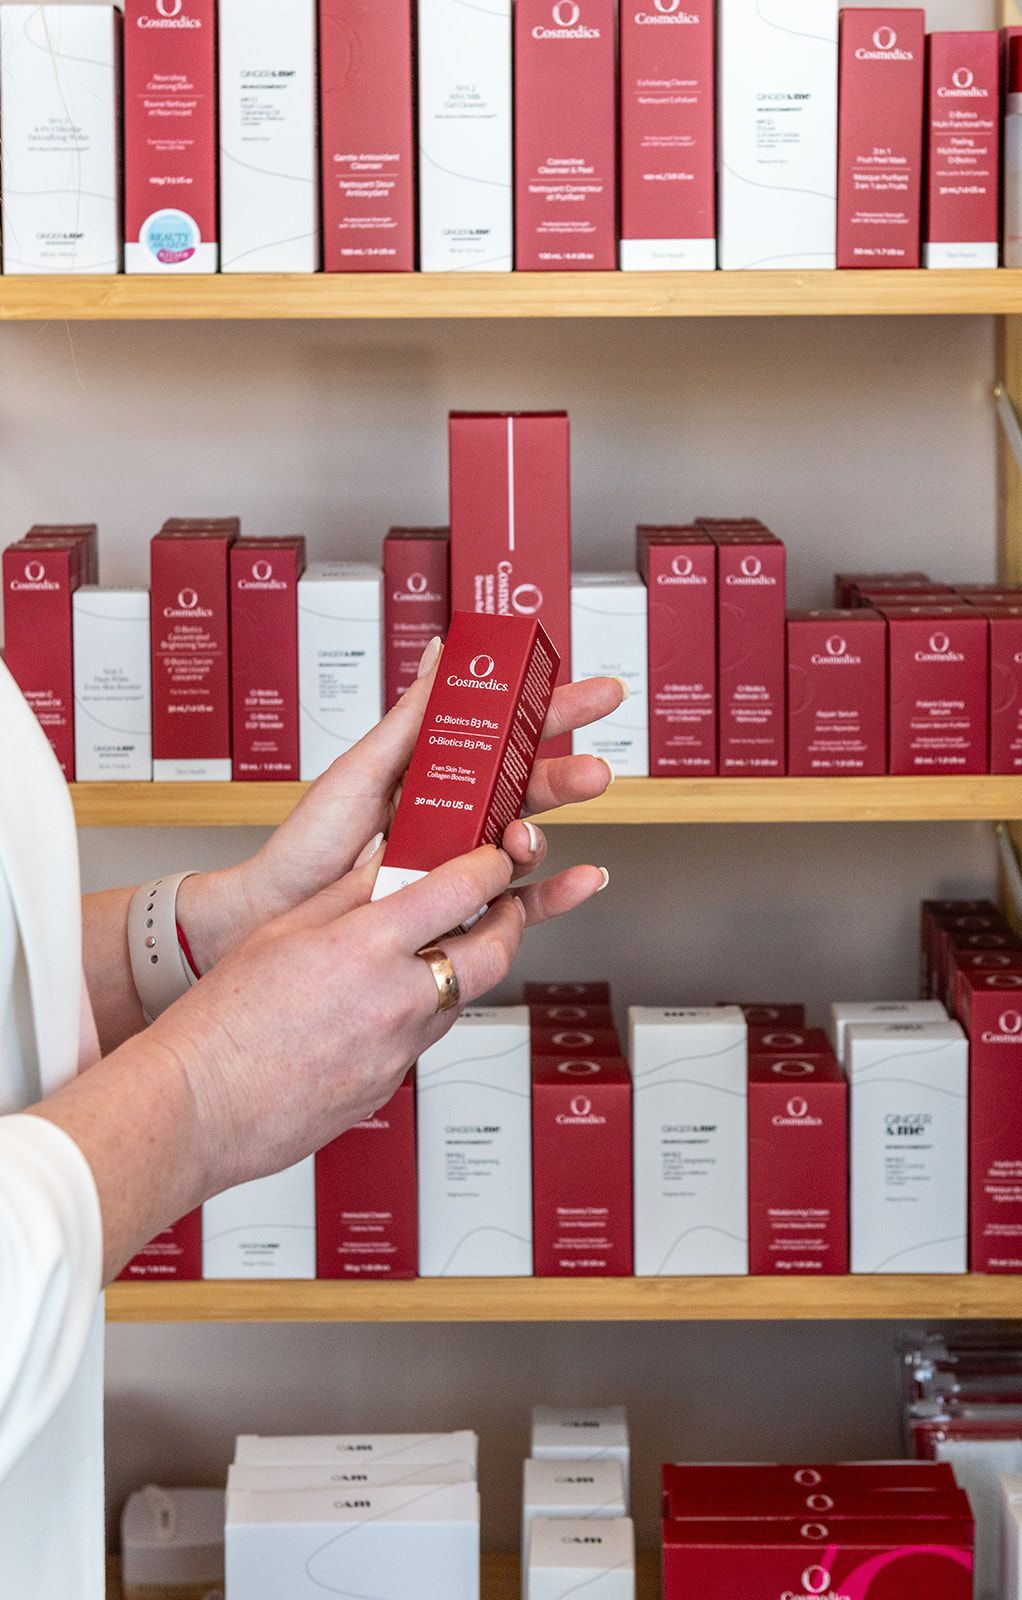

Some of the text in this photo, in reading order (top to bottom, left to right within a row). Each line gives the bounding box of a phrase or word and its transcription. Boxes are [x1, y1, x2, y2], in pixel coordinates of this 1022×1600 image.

[552, 1, 580, 27] O
[635, 13, 699, 24] Cosmedics
[137, 16, 201, 28] Cosmedics
[532, 26, 600, 38] Cosmedics
[873, 26, 897, 49] O
[855, 49, 913, 59] Cosmedics
[952, 68, 973, 87] O
[937, 87, 987, 97] Cosmedics
[351, 162, 382, 170] Cleanser
[151, 233, 189, 241] BEAUTY
[24, 561, 45, 581] O
[252, 561, 272, 580] O
[672, 555, 692, 575] O
[740, 556, 761, 576] O
[10, 581, 59, 590] Cosmedics
[238, 580, 287, 589] Cosmedics
[657, 576, 707, 584] Cosmedics
[726, 576, 776, 584] Cosmedics
[178, 588, 198, 608] O
[164, 608, 212, 617] Cosmedics
[470, 655, 494, 678] O
[435, 714, 498, 730] O-Biotics B3 Plus
[429, 737, 492, 751] O-Biotics B3 Plus
[431, 764, 444, 772] Even
[427, 770, 476, 784] Collagen Boosting
[415, 797, 425, 805] 30
[452, 801, 463, 809] US
[464, 803, 473, 811] oz
[887, 1127, 924, 1135] &me
